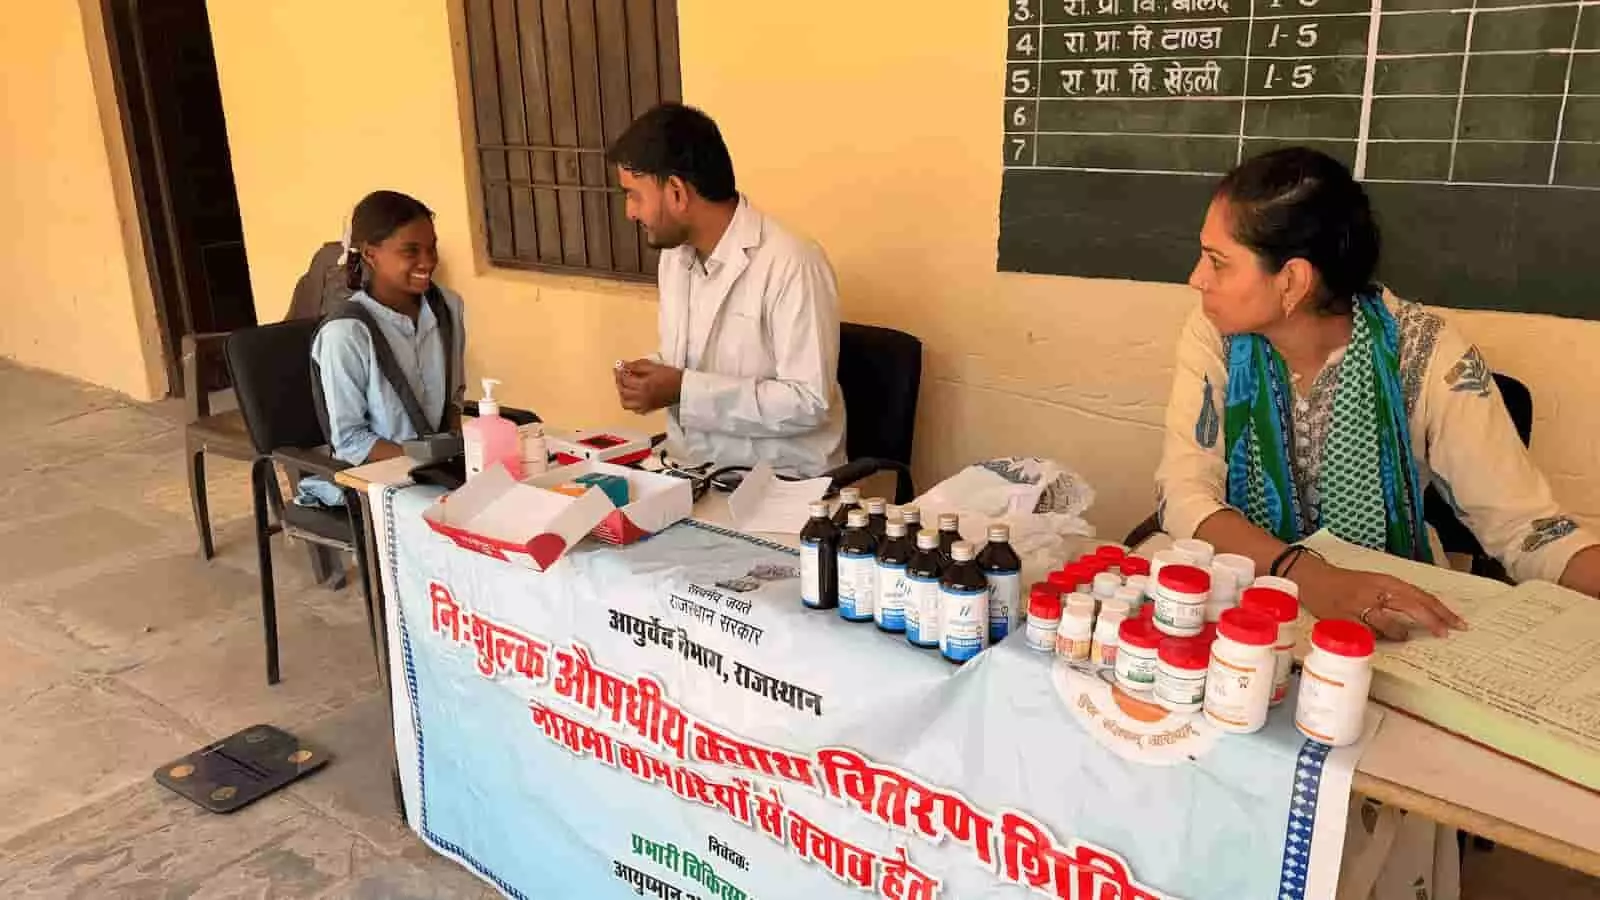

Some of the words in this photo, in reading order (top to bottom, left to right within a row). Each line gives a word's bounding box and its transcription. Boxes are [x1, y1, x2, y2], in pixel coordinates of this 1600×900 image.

[1161, 26, 1223, 50] टाण्डा
[1013, 106, 1026, 126] 6
[1011, 138, 1026, 161] 7
[720, 613, 765, 646] सरकार
[608, 608, 677, 651] आयुर्वेद
[734, 660, 824, 716] राजस्थान
[554, 643, 689, 758] औषधीय
[816, 748, 994, 865] वितरण
[631, 833, 682, 872] प्रभारी
[788, 810, 877, 887] बचाव
